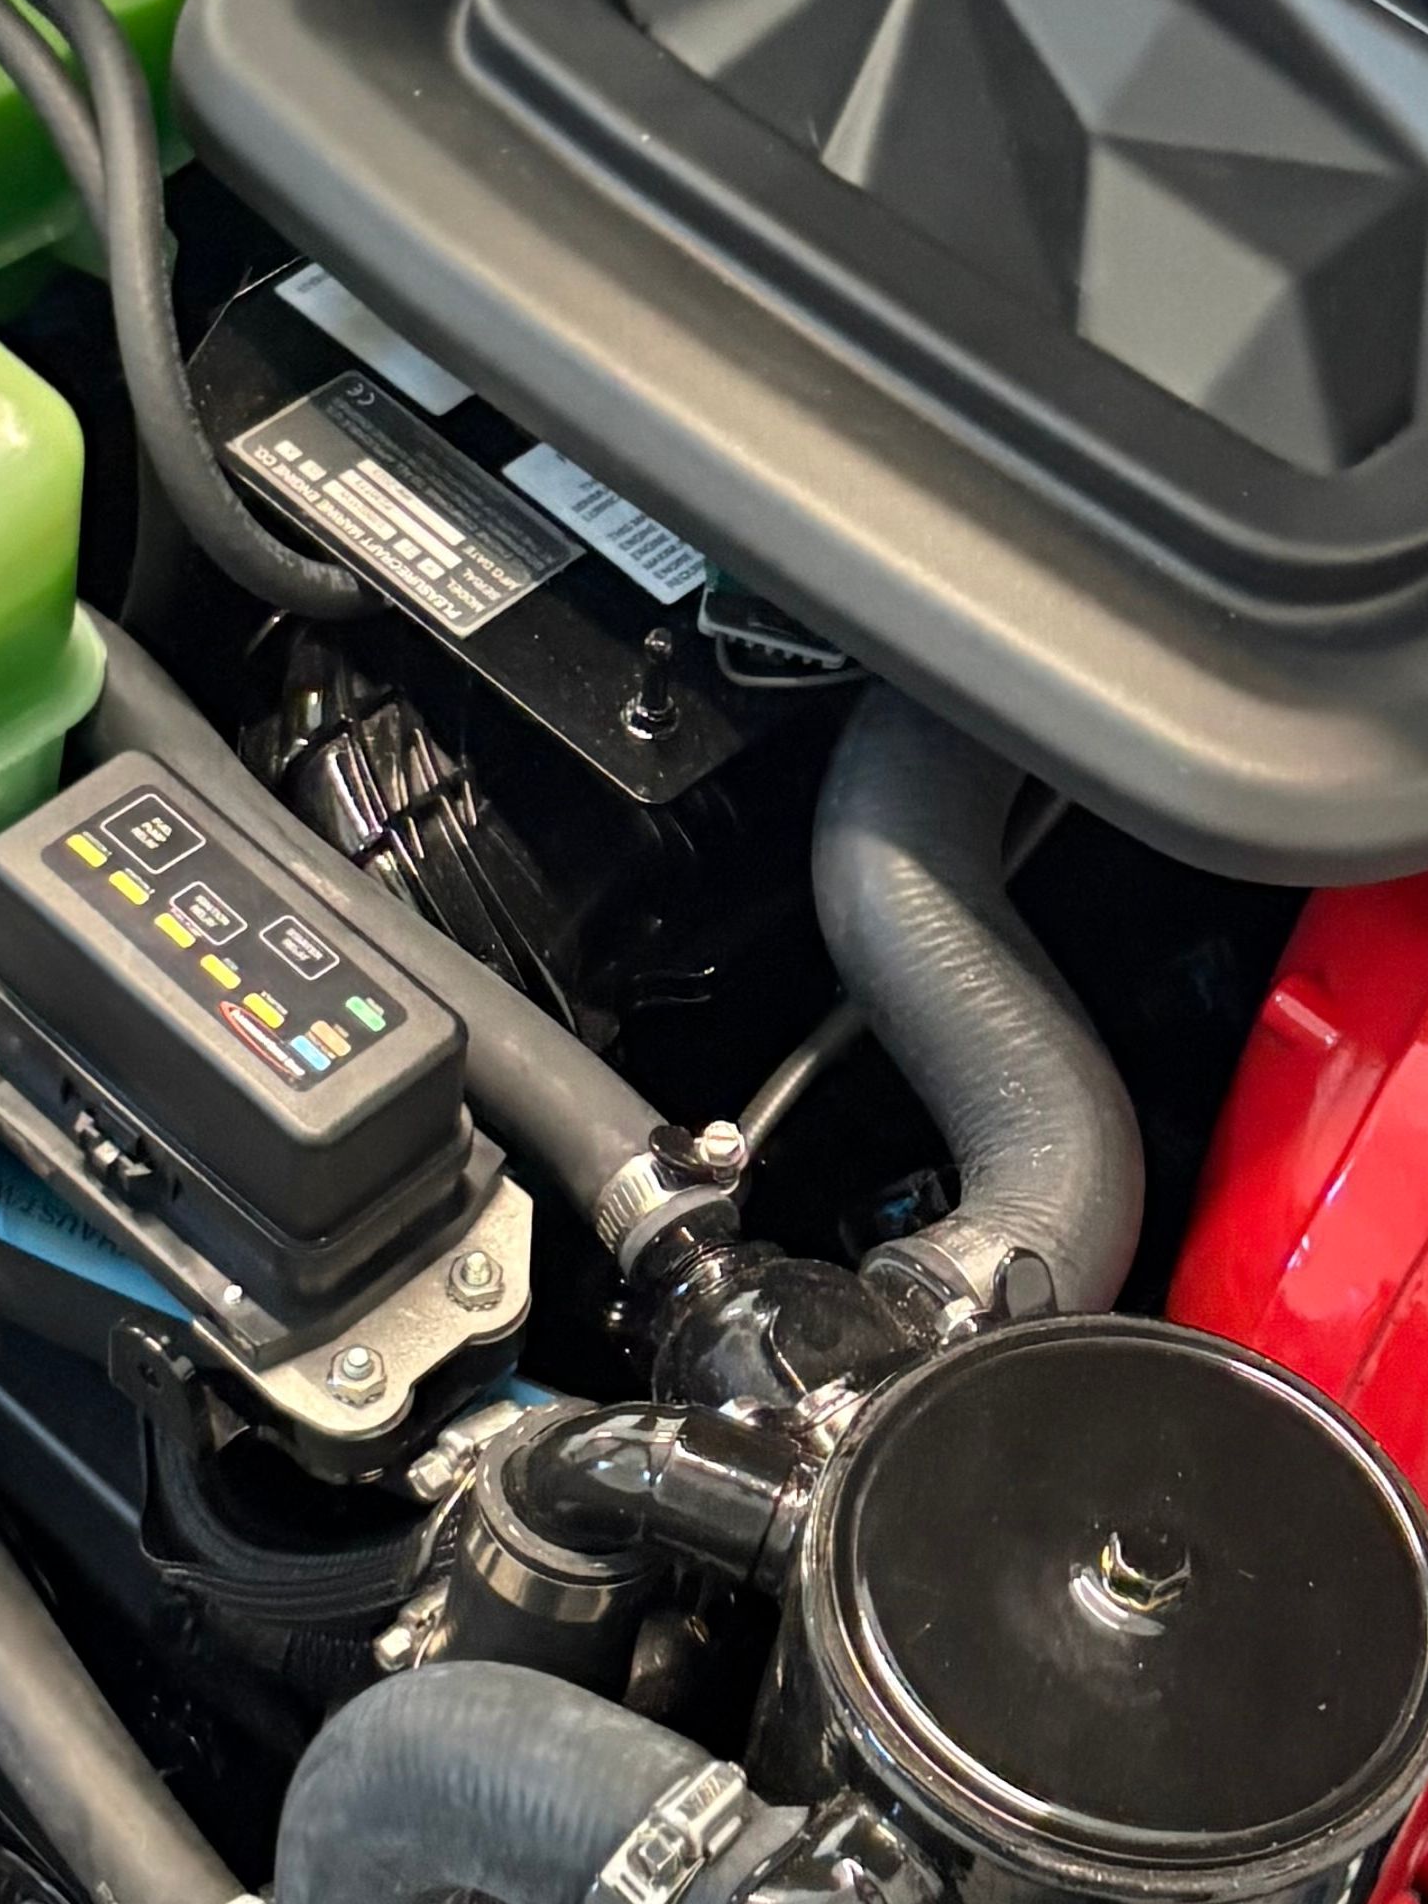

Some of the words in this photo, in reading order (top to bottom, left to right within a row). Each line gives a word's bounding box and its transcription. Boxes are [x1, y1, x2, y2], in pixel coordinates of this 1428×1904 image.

[270, 461, 322, 503] ENGINE
[461, 543, 497, 571] DATE
[357, 535, 463, 620] PLEASURECRAFT
[441, 576, 487, 613] MODEL
[458, 567, 502, 601] SERIAL
[488, 566, 521, 591] MFG
